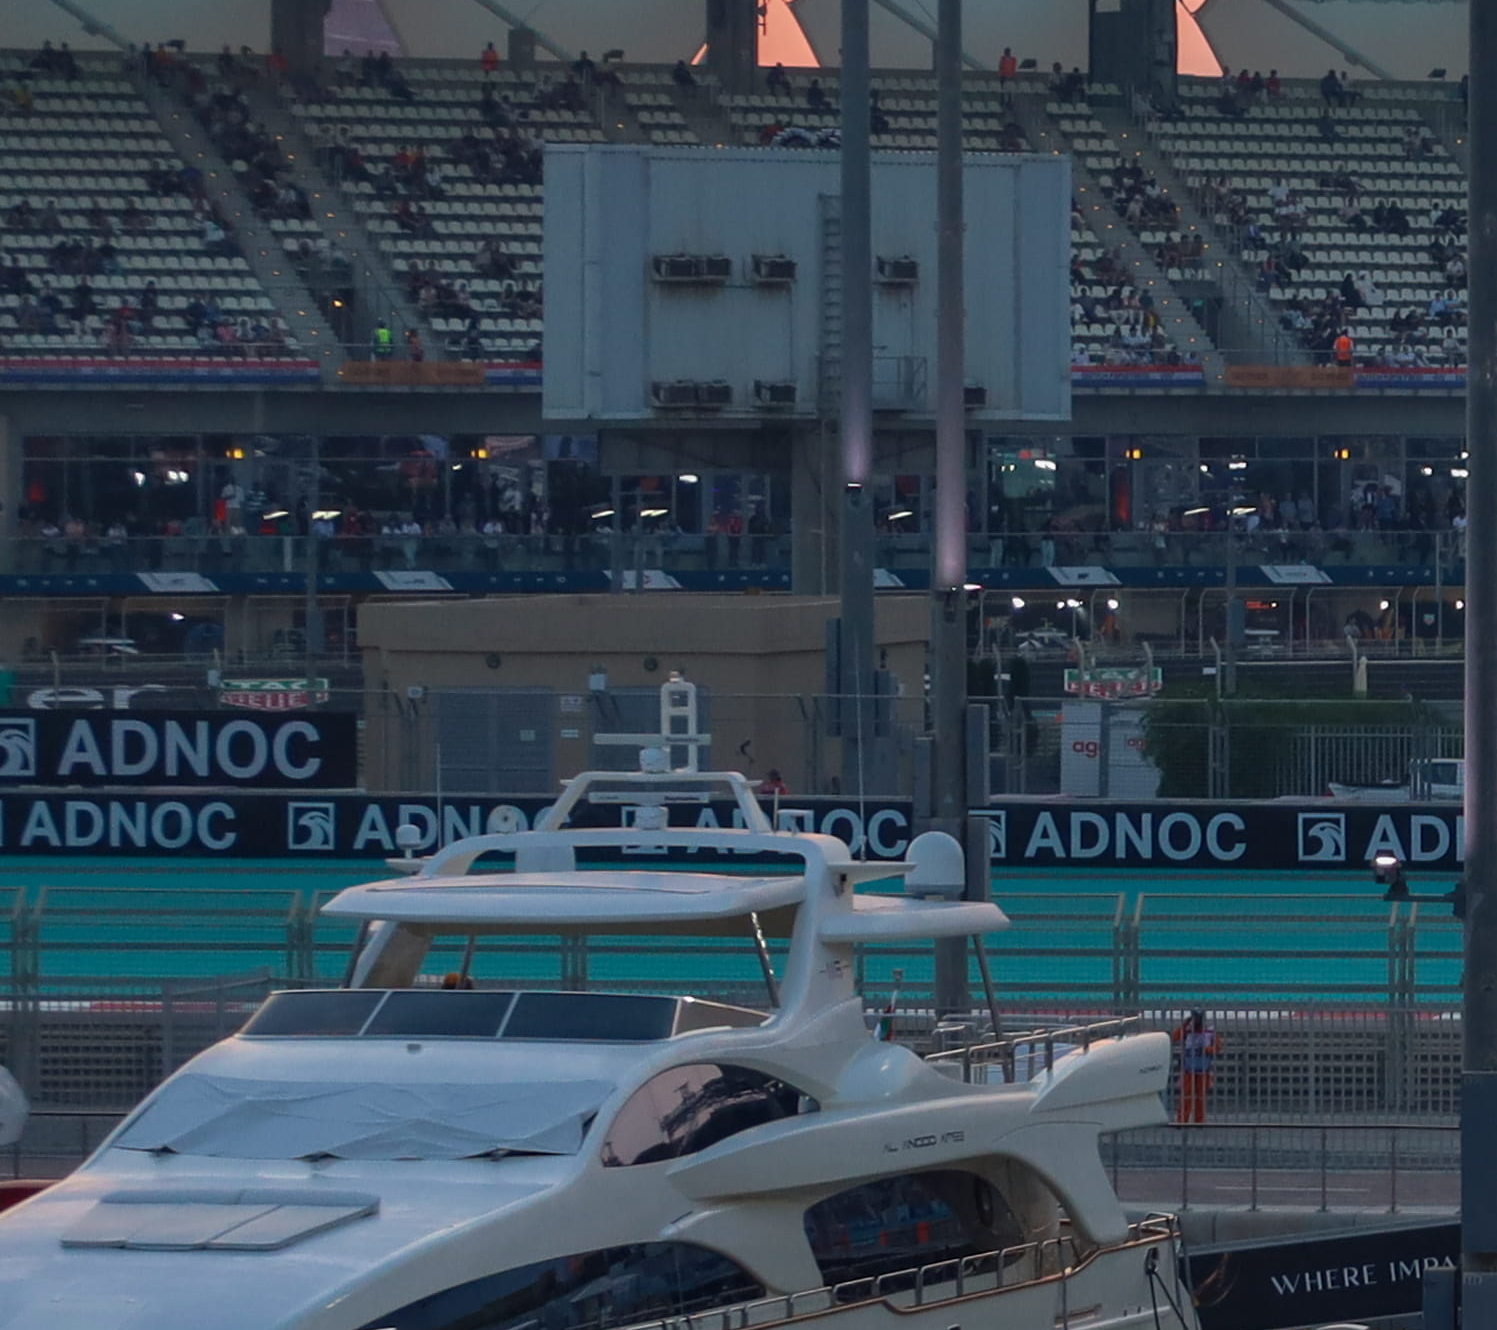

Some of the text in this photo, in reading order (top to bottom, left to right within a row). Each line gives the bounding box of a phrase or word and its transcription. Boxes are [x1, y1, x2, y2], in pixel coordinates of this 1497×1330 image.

[57, 718, 321, 780] ADNOC
[20, 800, 238, 850] ADNOC
[1025, 810, 1247, 860] ADNOC
[1271, 1263, 1378, 1297] WHERE
[1388, 1254, 1458, 1282] IMPA
